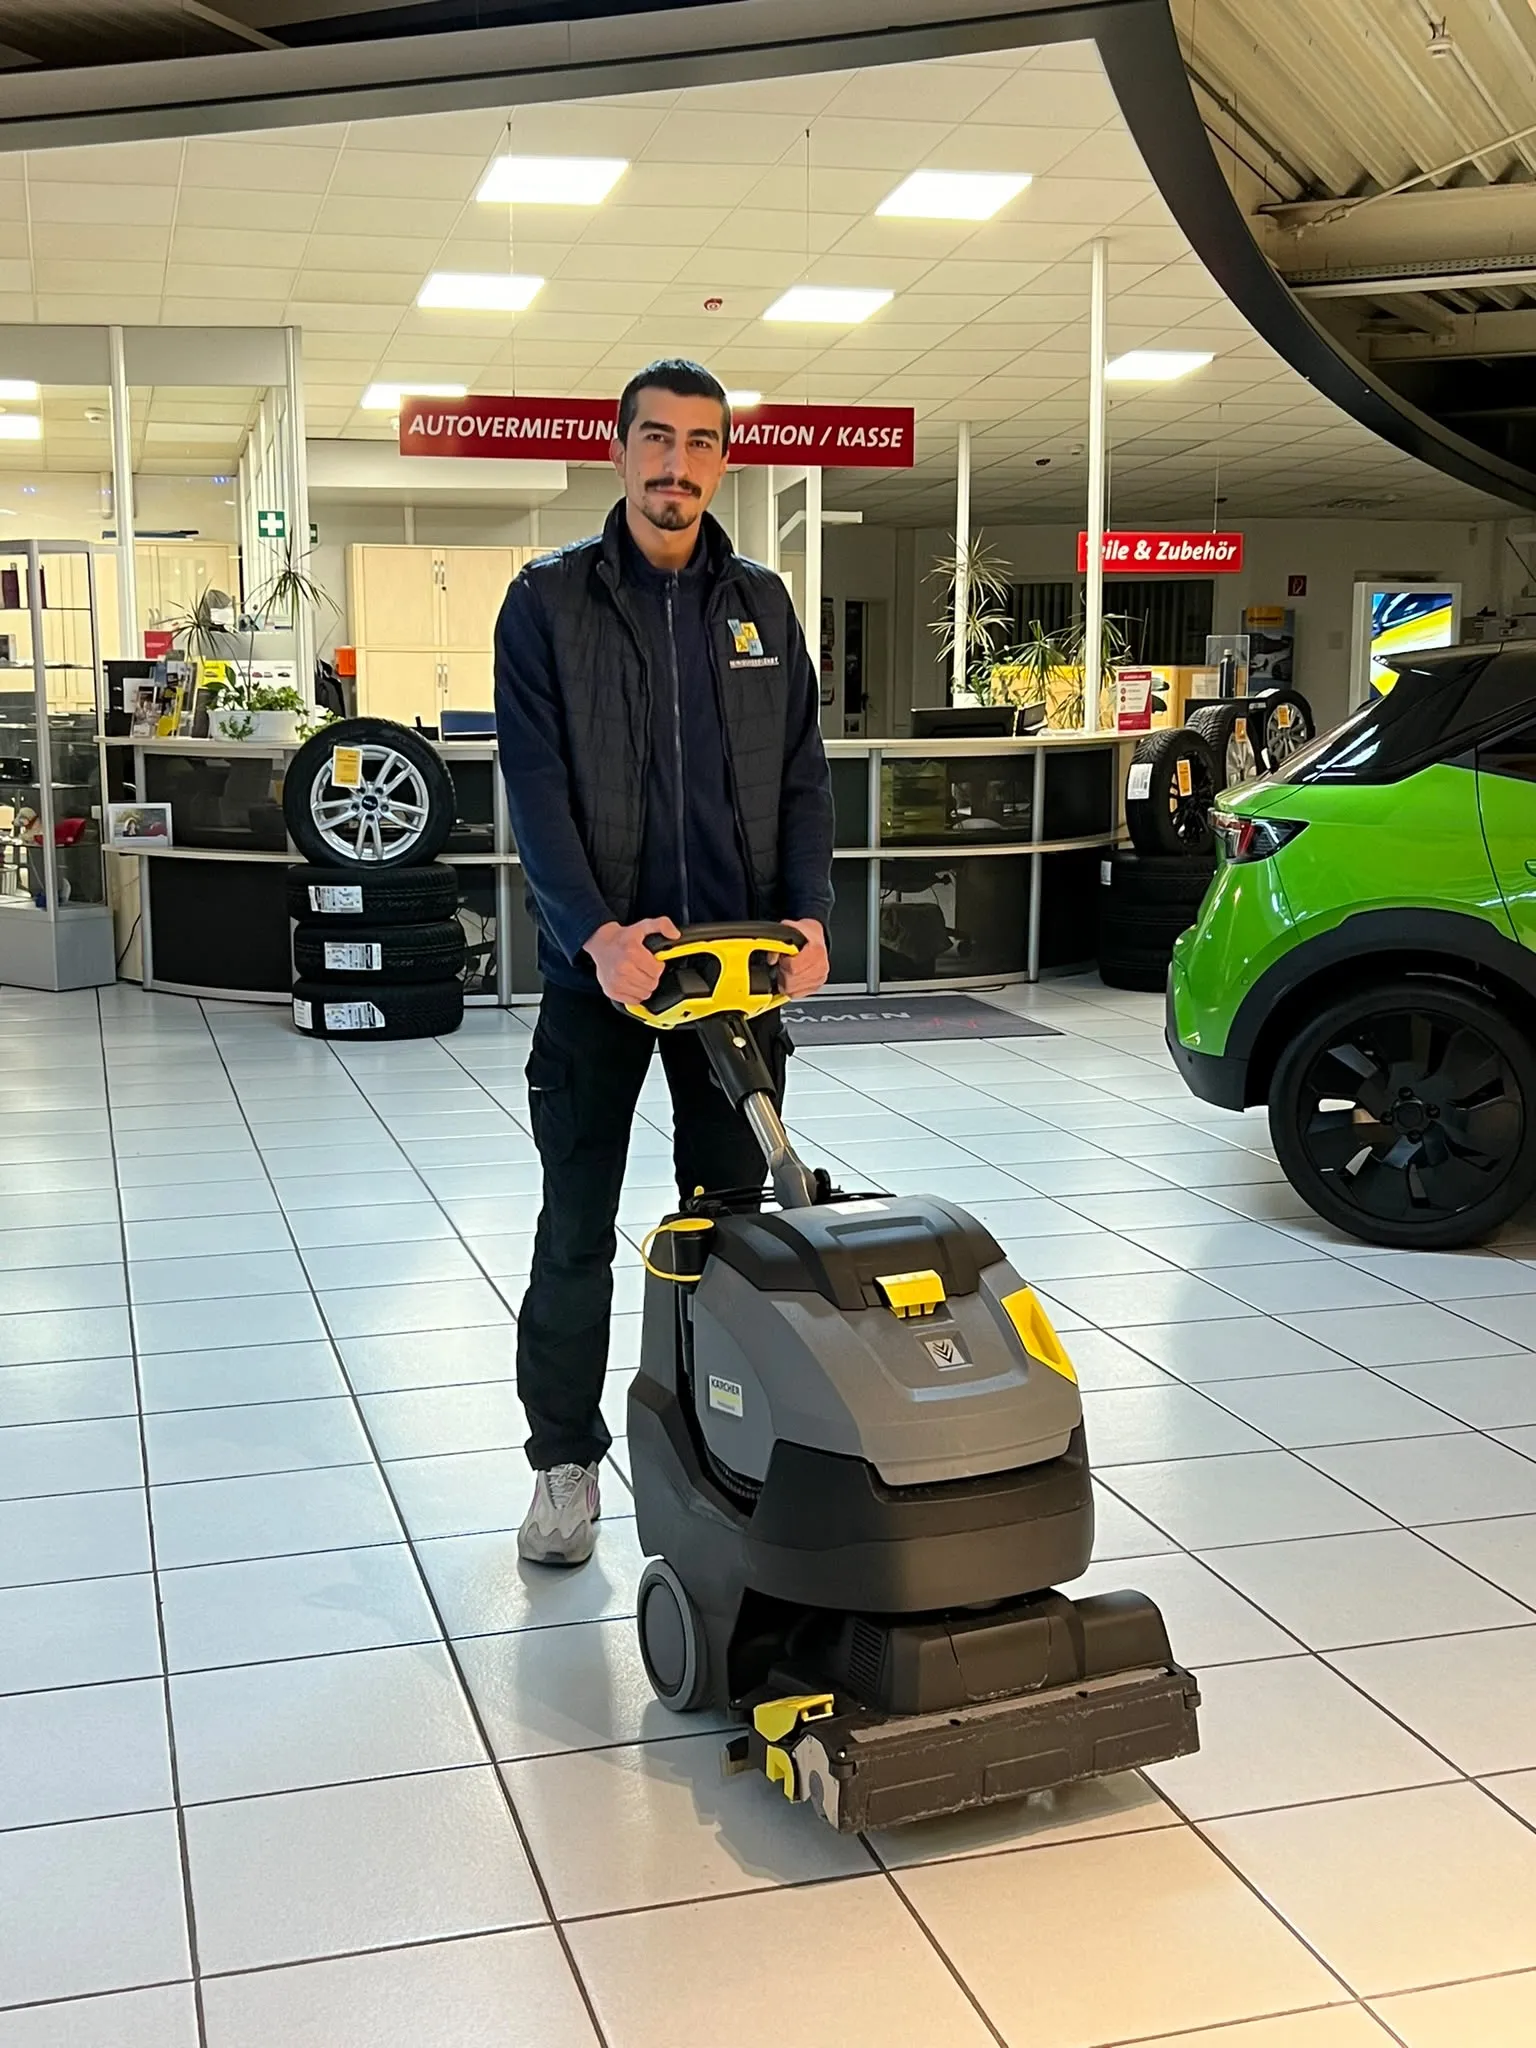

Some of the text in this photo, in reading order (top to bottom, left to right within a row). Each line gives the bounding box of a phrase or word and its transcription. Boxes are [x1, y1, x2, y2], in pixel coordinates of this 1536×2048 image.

[408, 414, 904, 448] AUTOVERMIETUN MATION / KASSE
[1133, 539, 1152, 561] &
[1156, 540, 1237, 561] Zubehör
